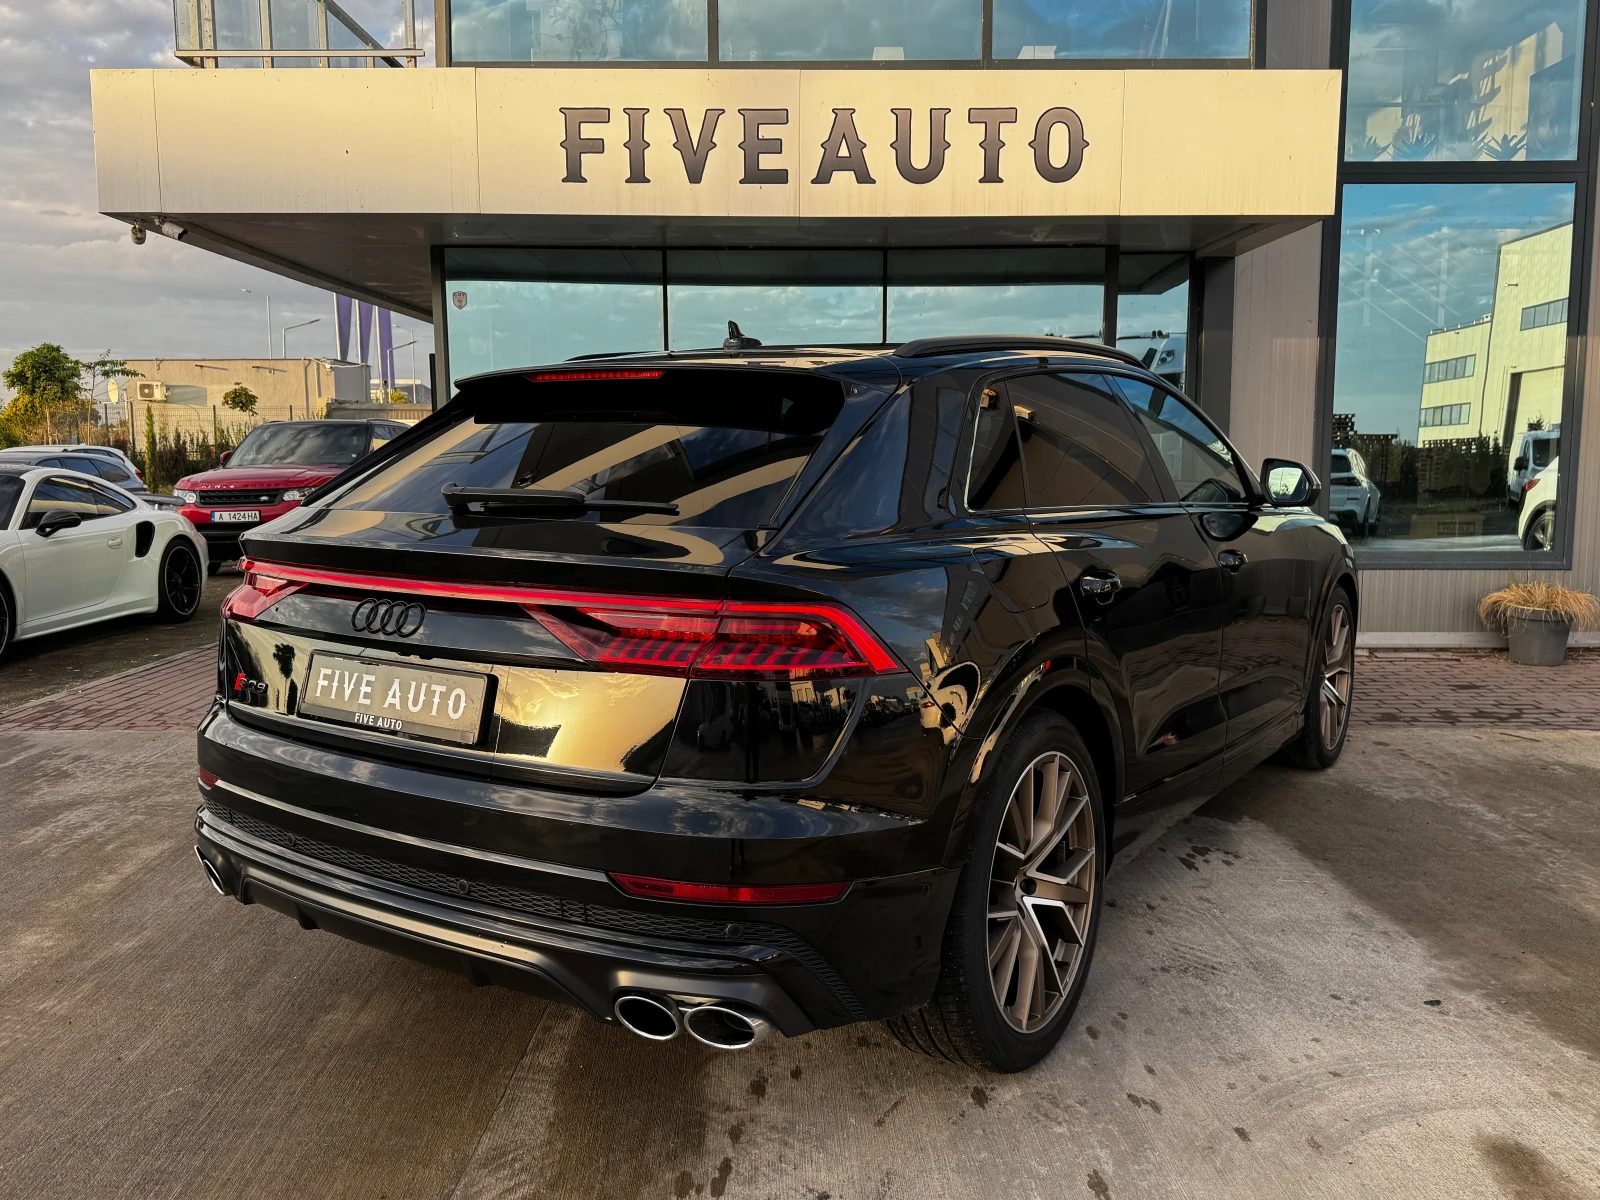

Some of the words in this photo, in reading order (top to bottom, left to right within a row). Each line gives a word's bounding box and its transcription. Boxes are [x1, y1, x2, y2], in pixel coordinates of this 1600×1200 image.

[559, 107, 789, 184] FIVE
[810, 106, 1090, 184] AUTO
[315, 667, 376, 705] FIVE
[382, 678, 467, 720] AUTO
[354, 712, 375, 725] FIVE
[377, 717, 403, 730] AUTO
